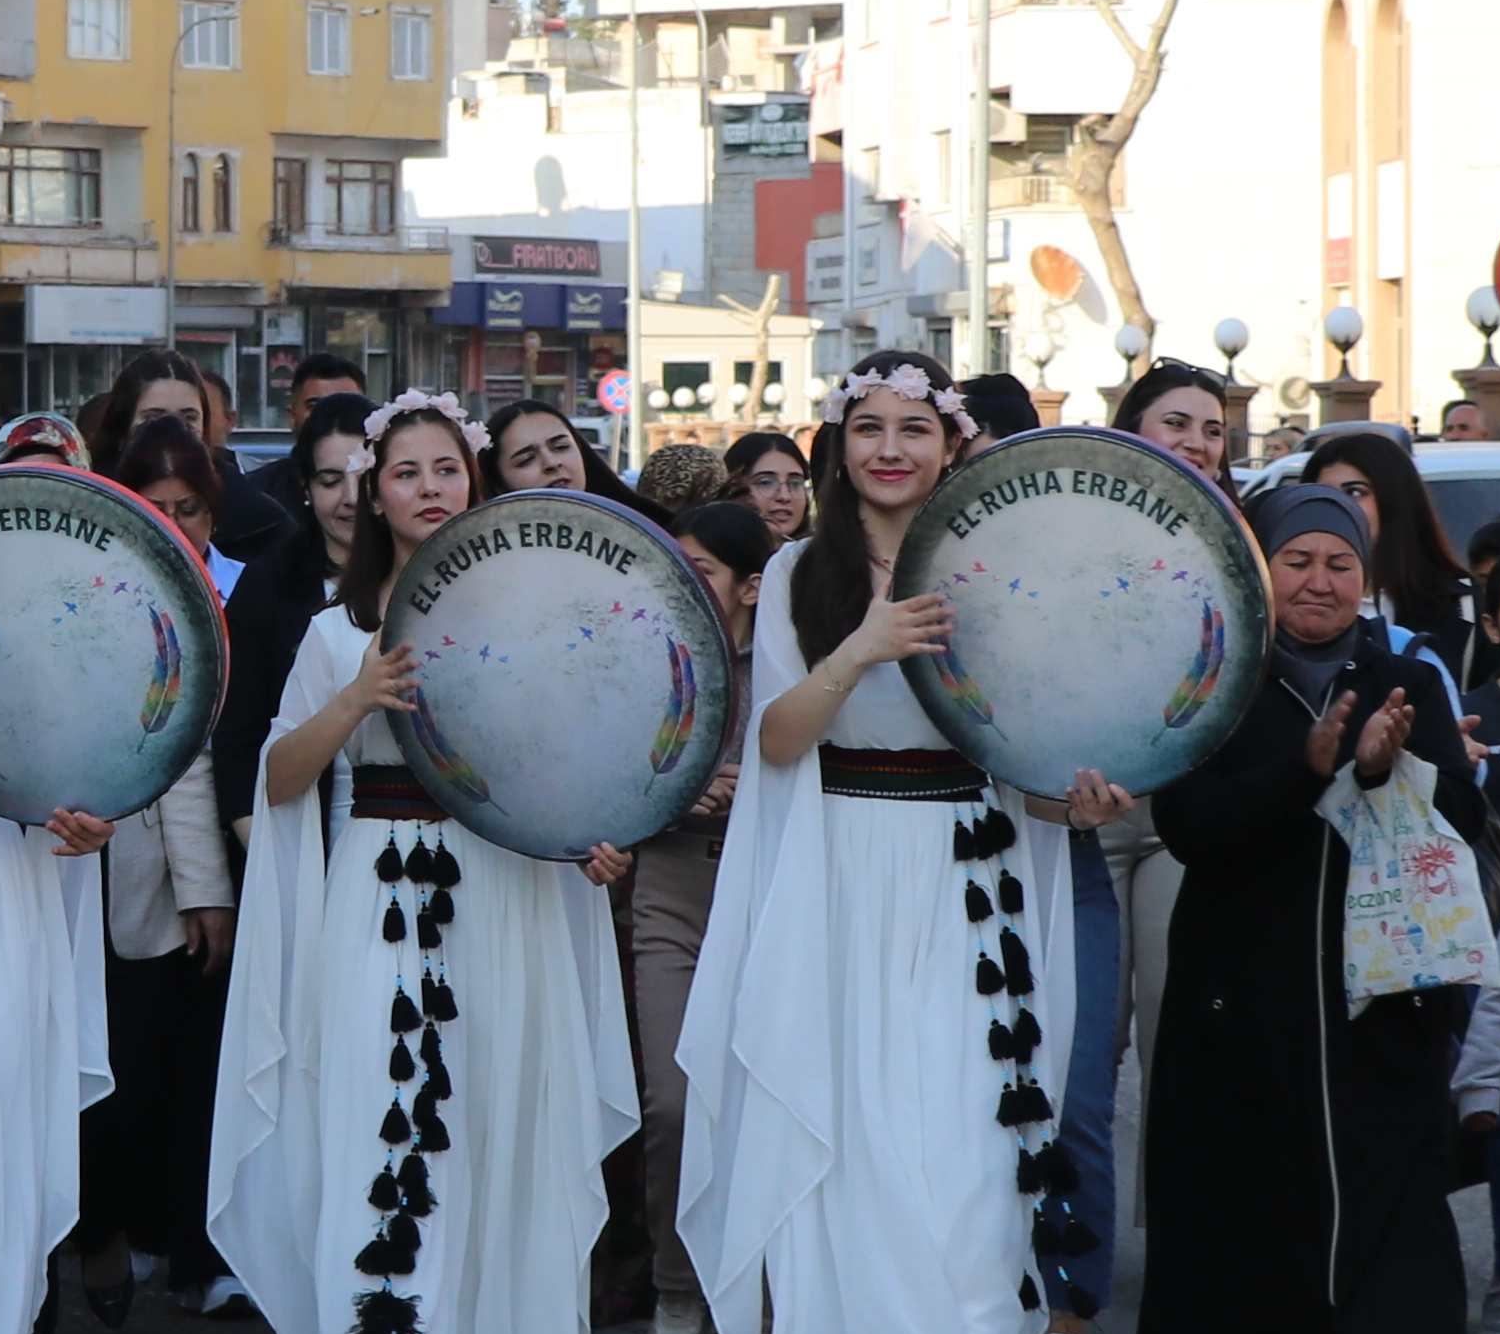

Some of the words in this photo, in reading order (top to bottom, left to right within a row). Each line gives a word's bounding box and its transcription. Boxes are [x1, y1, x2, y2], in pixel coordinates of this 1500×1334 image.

[946, 470, 1063, 540] EL-RUHA
[1071, 469, 1189, 537] ERBANE
[408, 527, 512, 616] EL-RUHA
[518, 522, 637, 575] ERBANE
